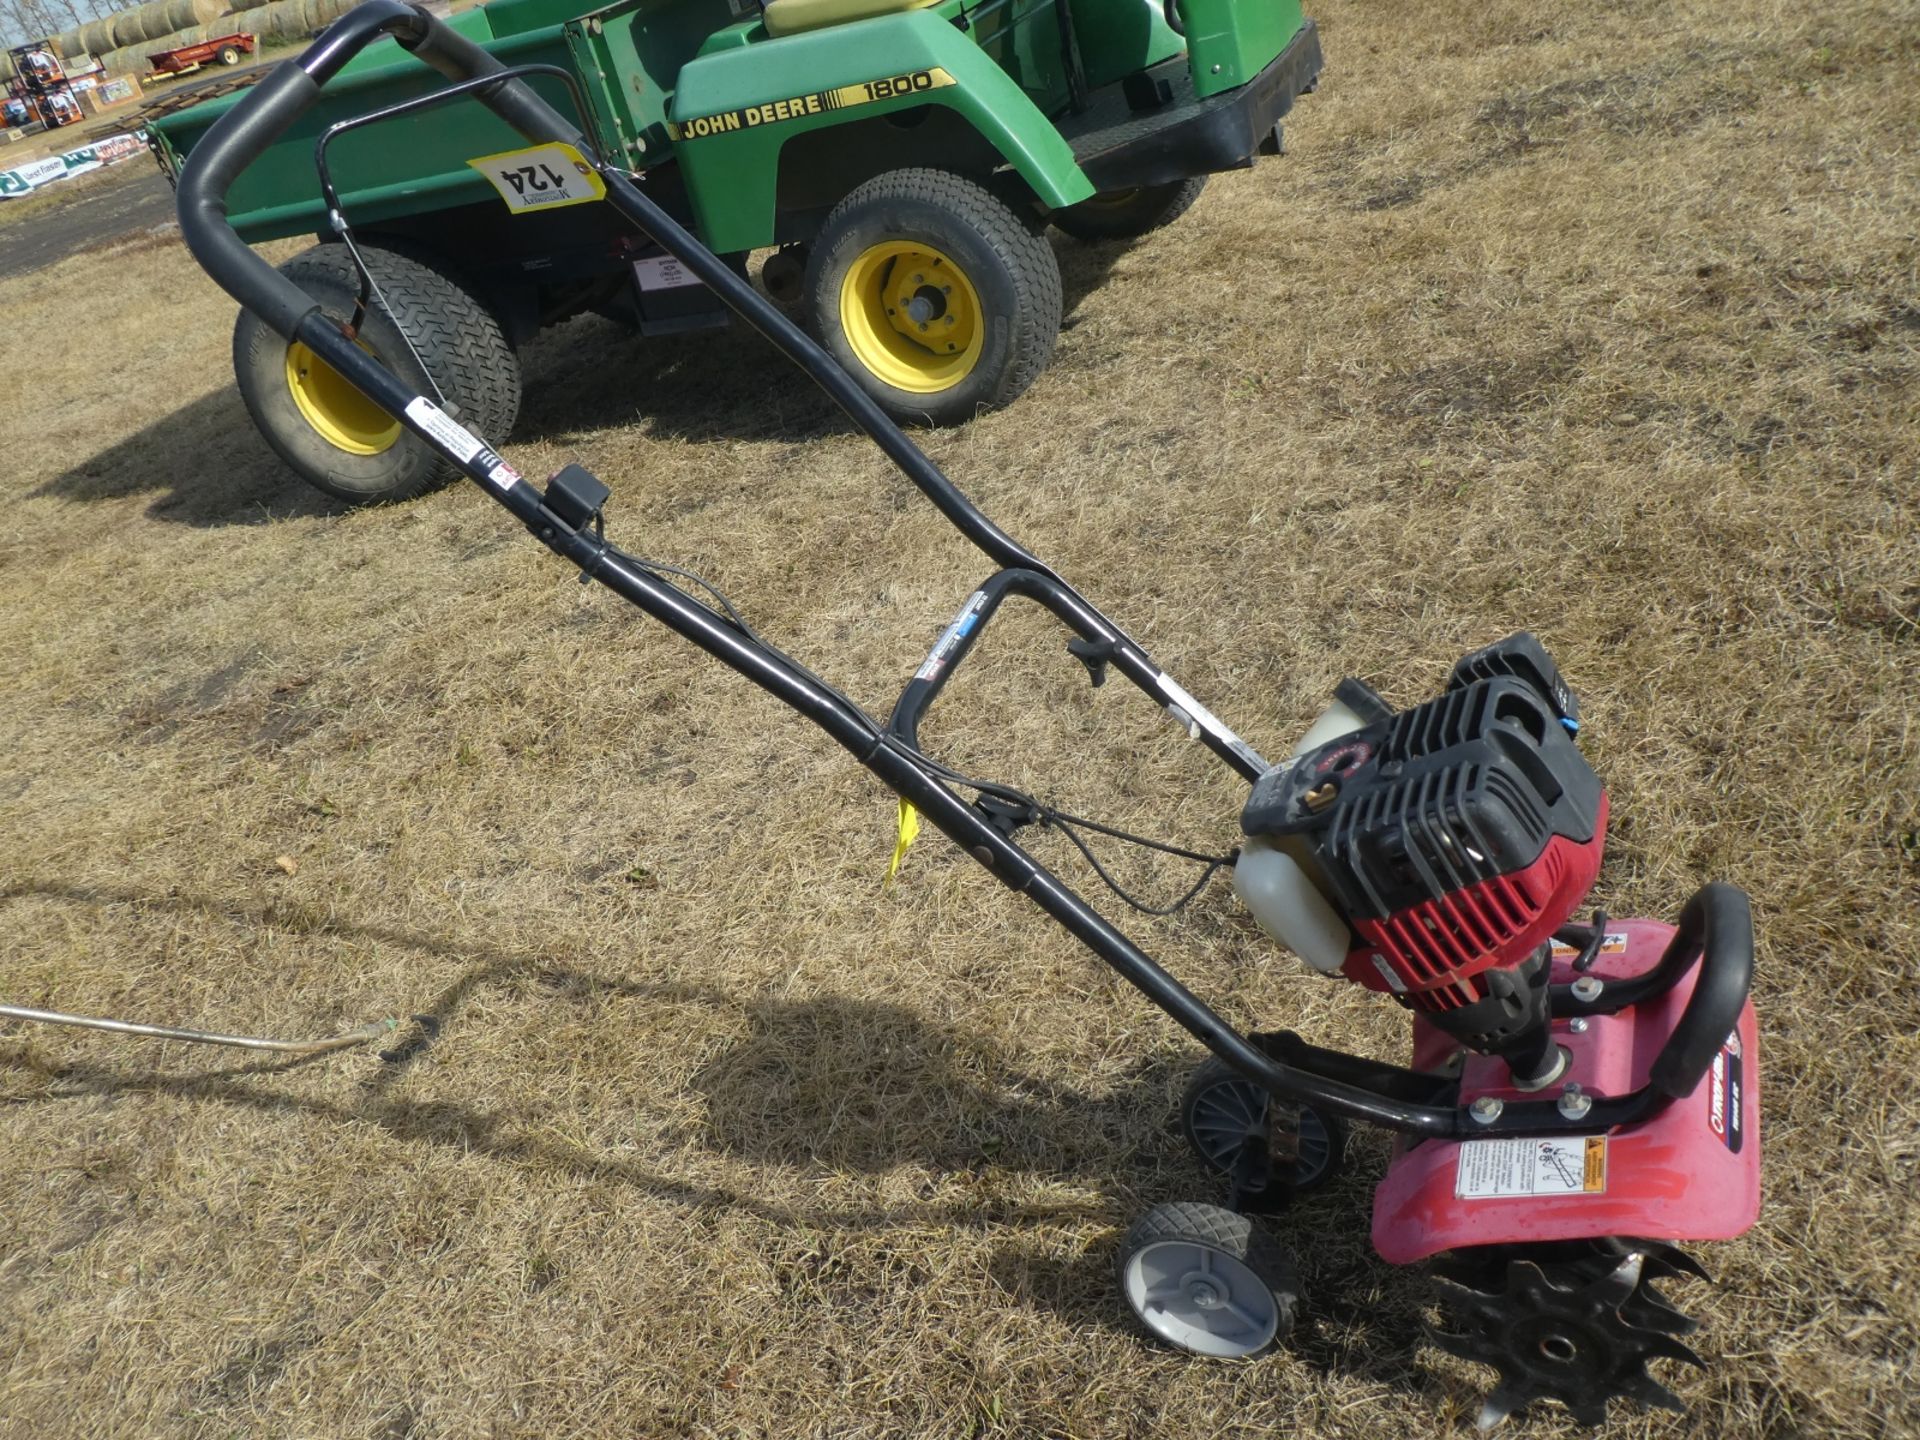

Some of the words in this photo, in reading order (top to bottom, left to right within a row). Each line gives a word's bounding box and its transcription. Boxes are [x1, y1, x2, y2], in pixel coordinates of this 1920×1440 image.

[685, 112, 740, 139] JOHN
[746, 95, 822, 127] DEERE
[863, 71, 932, 100] 1800
[501, 164, 564, 194] 124
